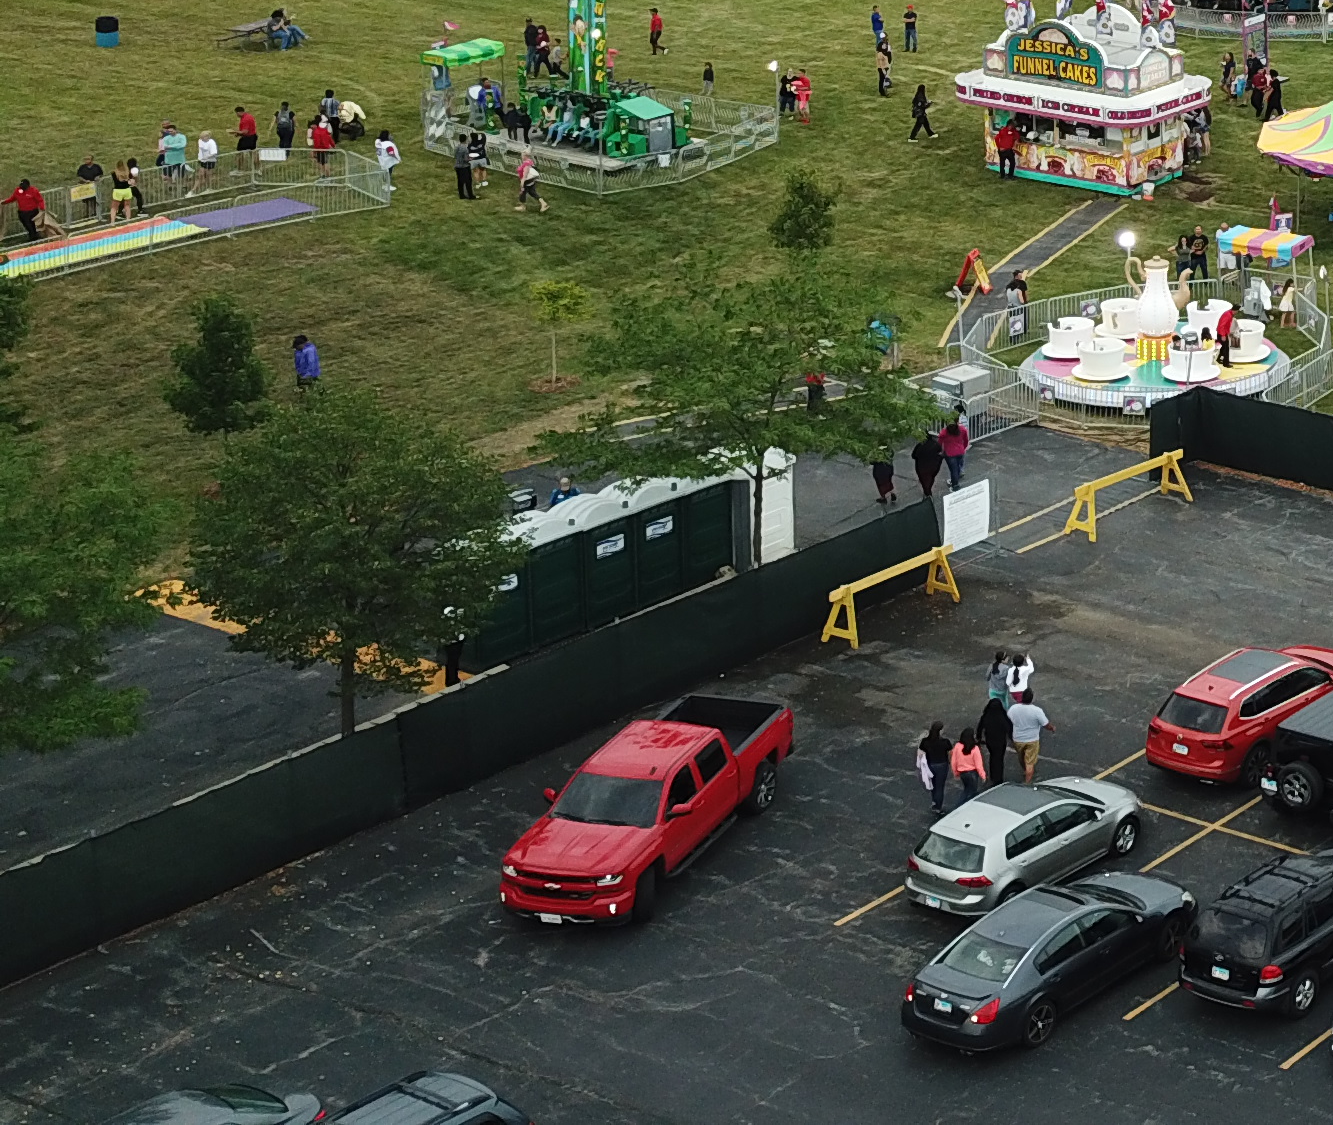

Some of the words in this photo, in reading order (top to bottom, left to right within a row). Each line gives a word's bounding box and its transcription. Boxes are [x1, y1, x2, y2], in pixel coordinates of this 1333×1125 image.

[1018, 38, 1090, 61] JESSICA'S
[1013, 55, 1056, 77] FUNNEL
[1059, 61, 1098, 86] CAKES
